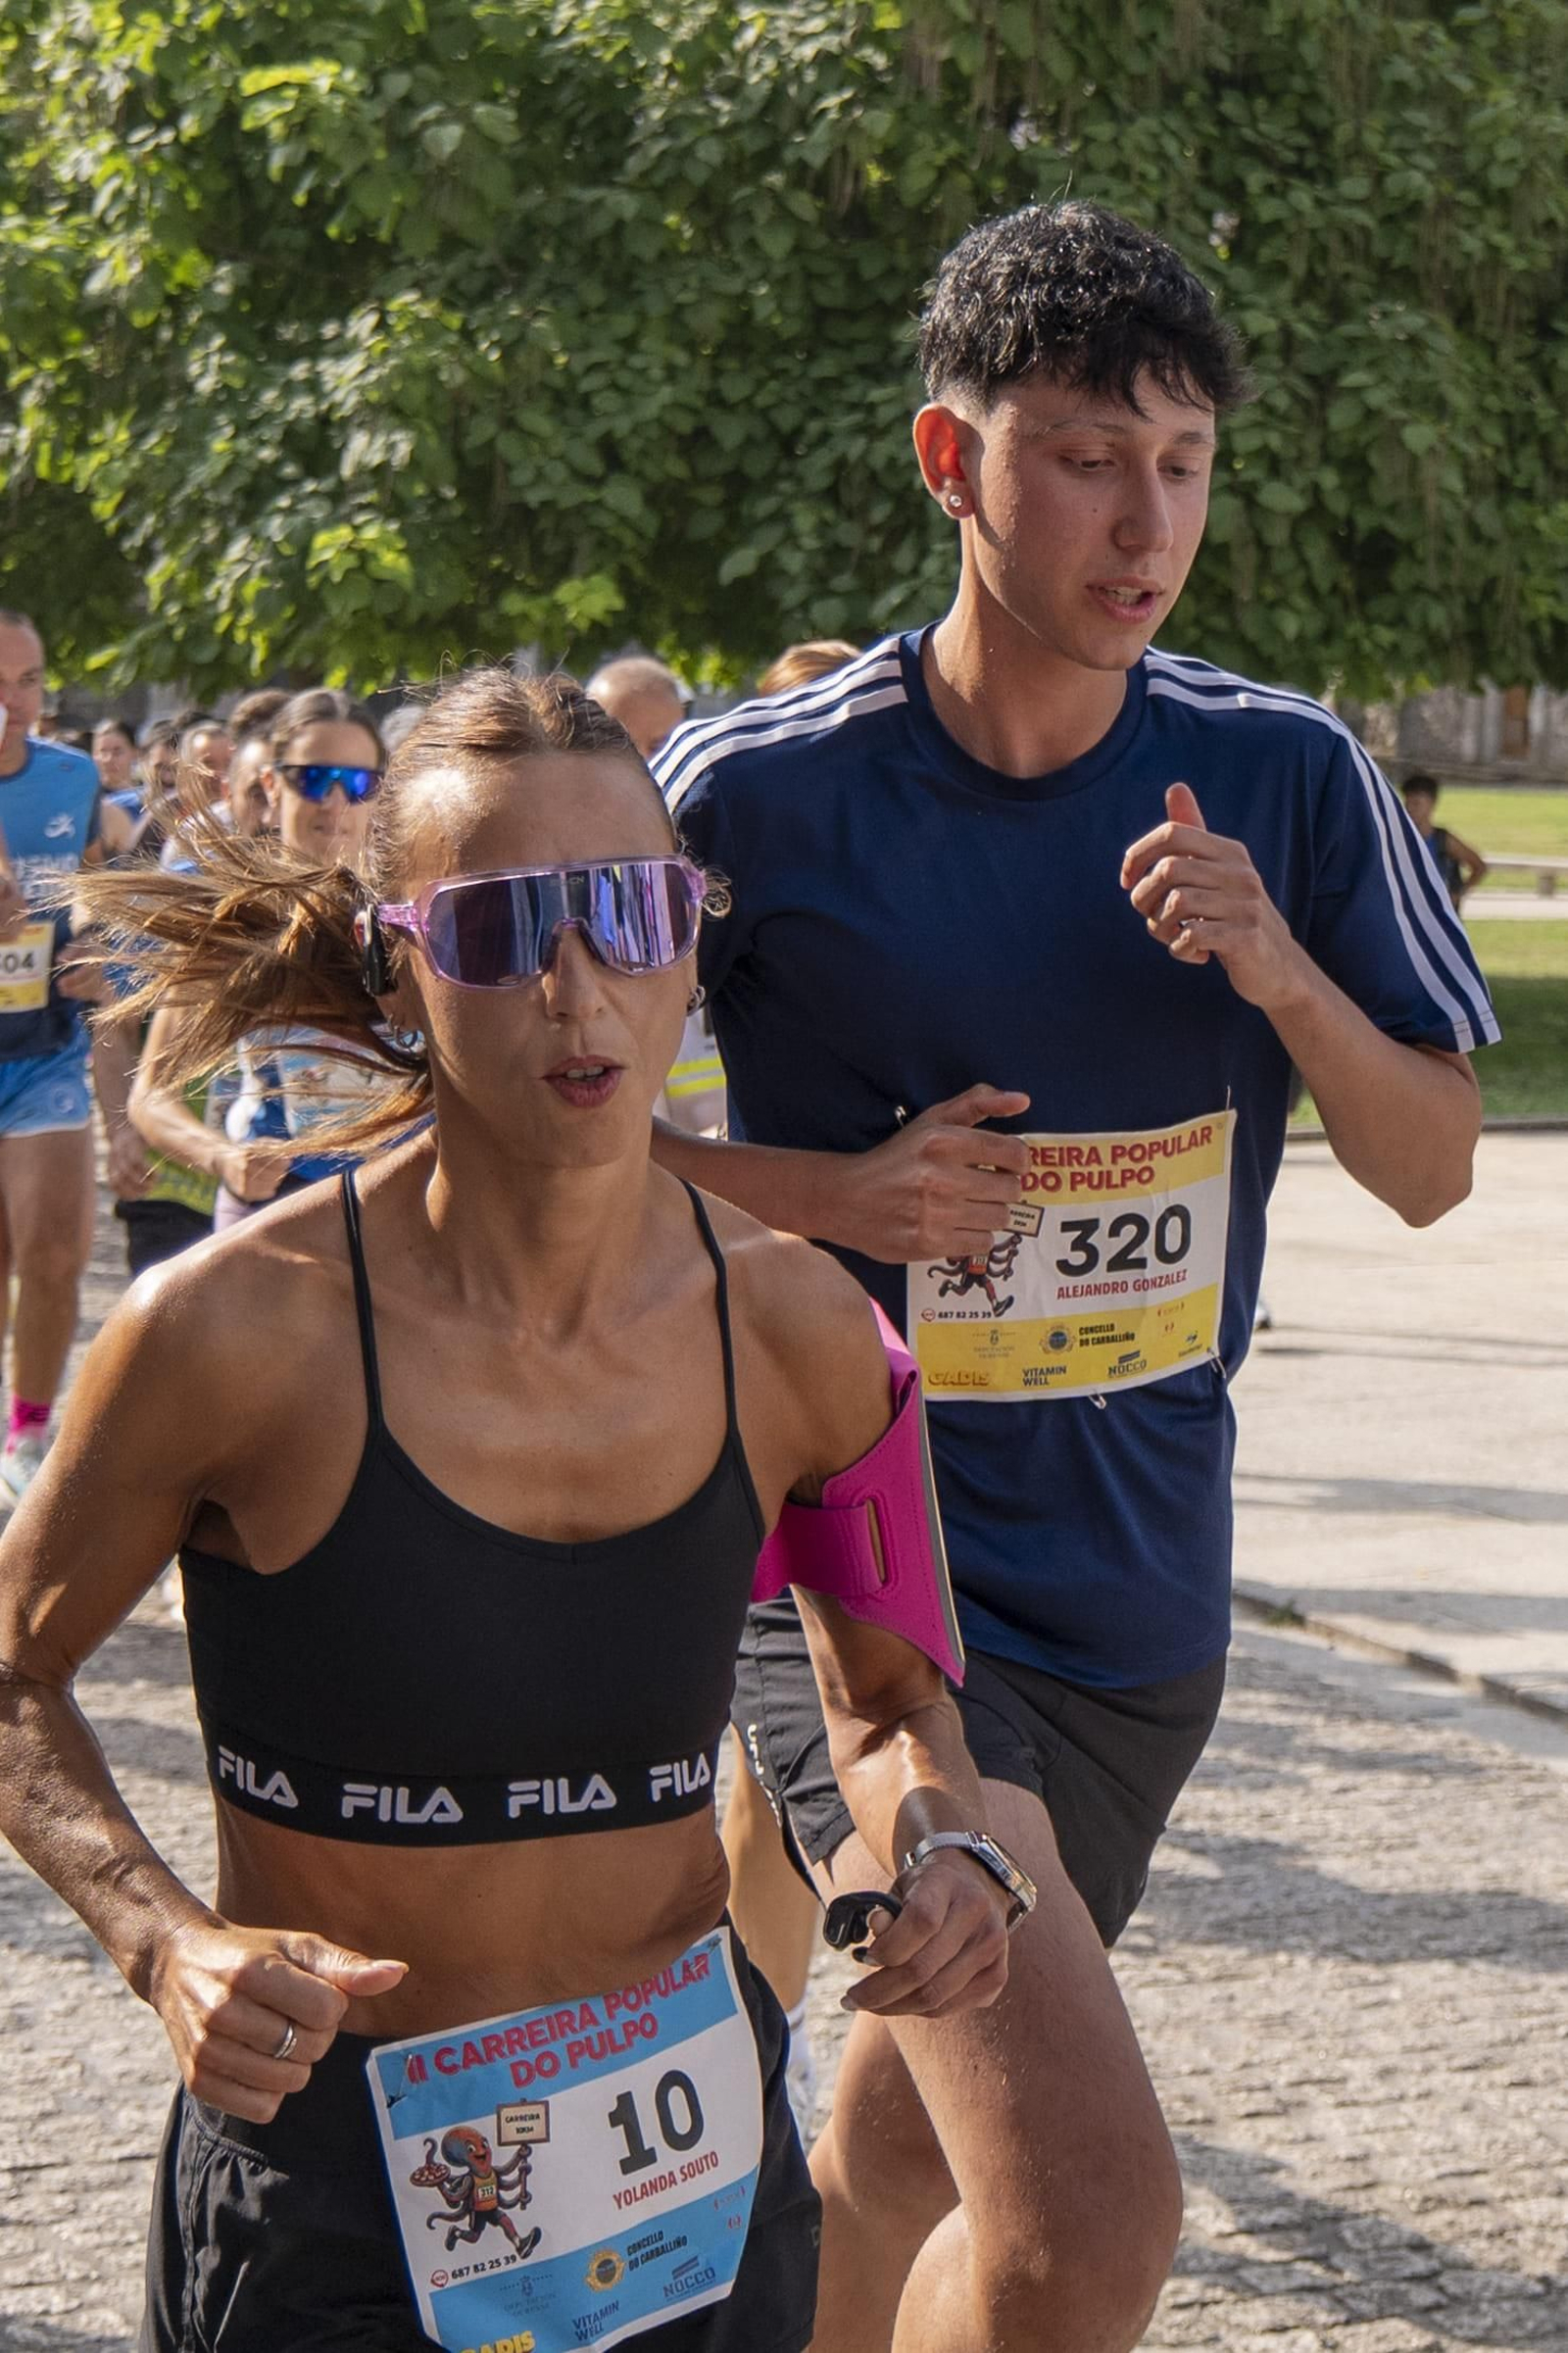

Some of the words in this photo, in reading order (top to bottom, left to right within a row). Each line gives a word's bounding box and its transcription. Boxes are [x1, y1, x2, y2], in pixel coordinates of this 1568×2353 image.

[0, 952, 34, 974] 04
[1029, 1145, 1102, 1167] REIRA
[1110, 1126, 1212, 1165] POPULAR
[1020, 1171, 1062, 1193] DO
[1069, 1166, 1154, 1192] PULPO
[1055, 1203, 1191, 1277] 320
[1057, 1280, 1129, 1300] ALEJANDRO
[1133, 1268, 1188, 1293] GONZALEZ
[1022, 1366, 1067, 1378] VITAMIN
[1022, 1377, 1050, 1387] WELL
[1108, 1359, 1148, 1376] NOCCO
[218, 1744, 299, 1809] FILA
[340, 1784, 464, 1824] FILA
[507, 1773, 618, 1819] FILA
[649, 1751, 711, 1803] FILA
[433, 2002, 602, 2076] CARREIRA
[603, 1952, 710, 2021] POPULAR
[510, 2049, 562, 2089] DO
[565, 2012, 659, 2070] PULPO
[608, 2069, 704, 2176] 10
[612, 2171, 678, 2211] YOLANDA
[679, 2150, 719, 2182] SOUTO
[626, 2230, 664, 2257] CONCELLO
[451, 2266, 470, 2279] 687
[472, 2262, 487, 2274] 82
[488, 2258, 502, 2270] 25
[504, 2254, 517, 2266] 39
[662, 2266, 716, 2298] NOCCO
[571, 2300, 619, 2330] VITAMIN
[461, 2330, 536, 2353] DIS
[573, 2322, 605, 2341] WELL
